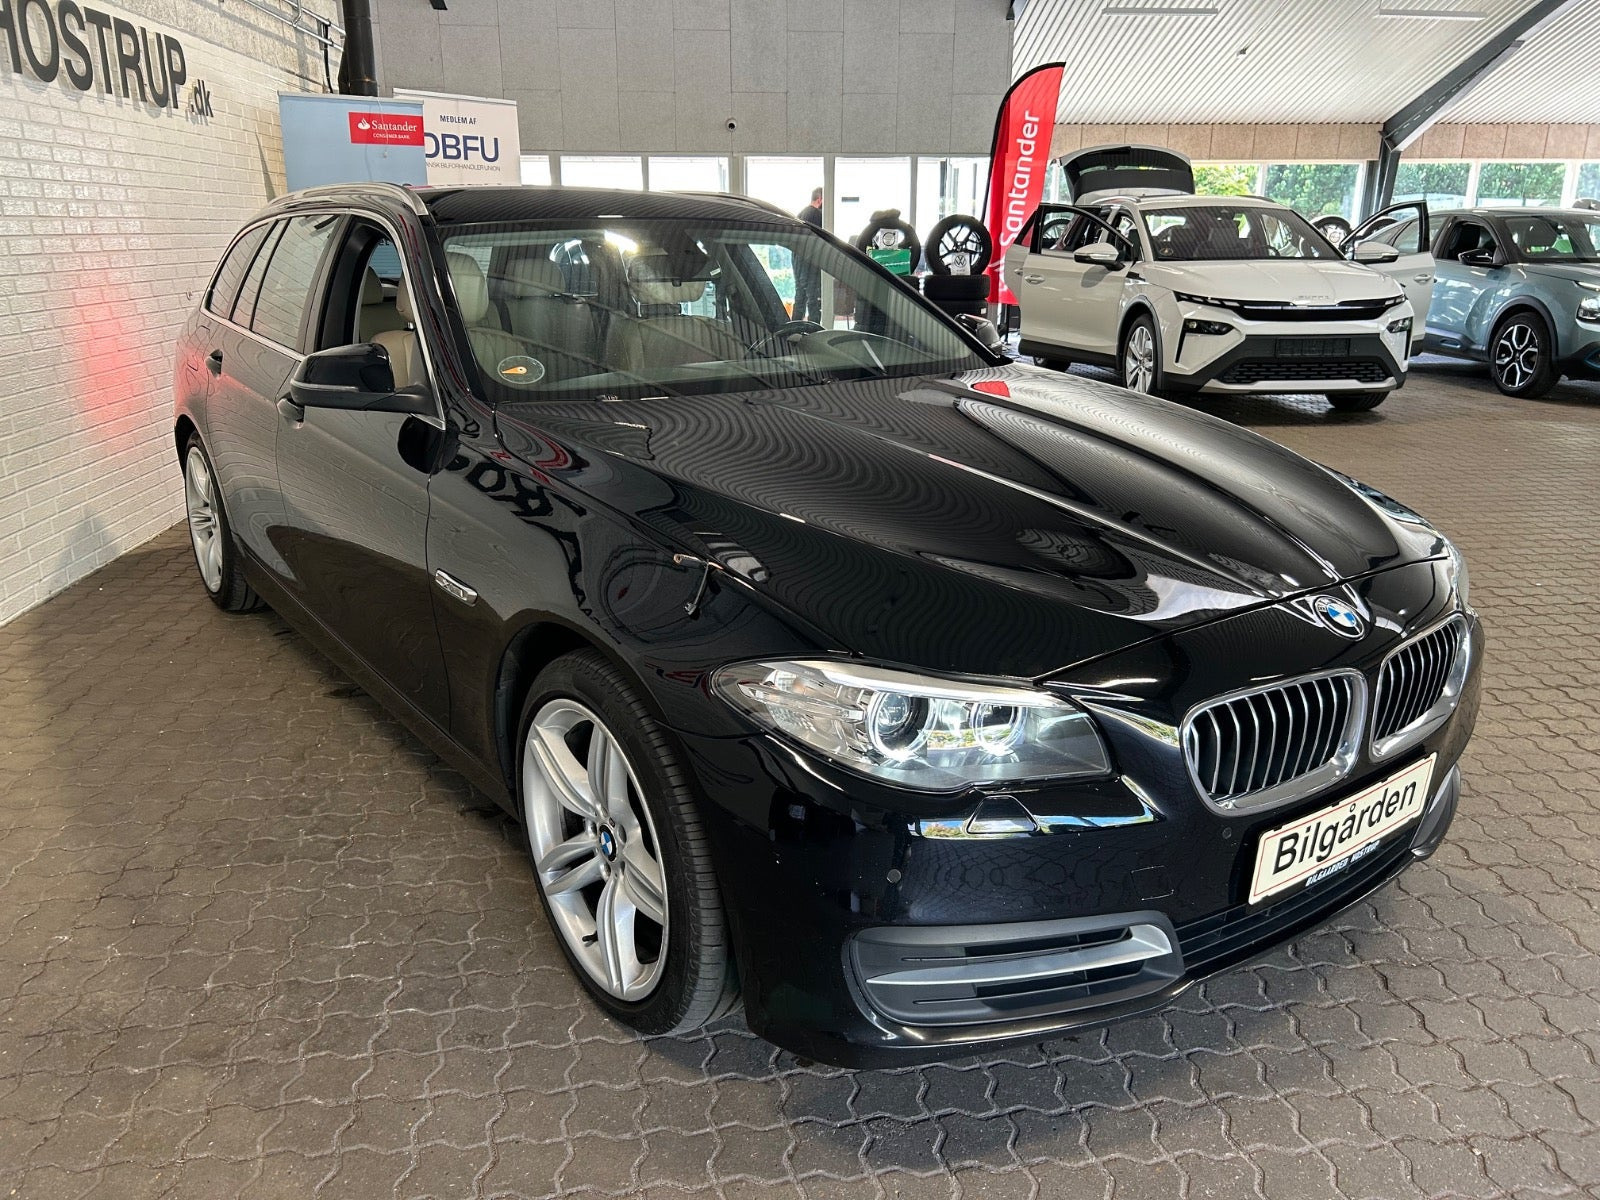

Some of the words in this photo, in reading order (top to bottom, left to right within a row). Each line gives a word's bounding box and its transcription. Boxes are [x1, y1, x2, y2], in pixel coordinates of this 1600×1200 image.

[371, 120, 417, 132] Santander
[439, 115, 468, 124] MEDLEM
[424, 132, 499, 163] DBFU
[999, 110, 1040, 246] Santander
[1272, 781, 1417, 875] Bilgården
